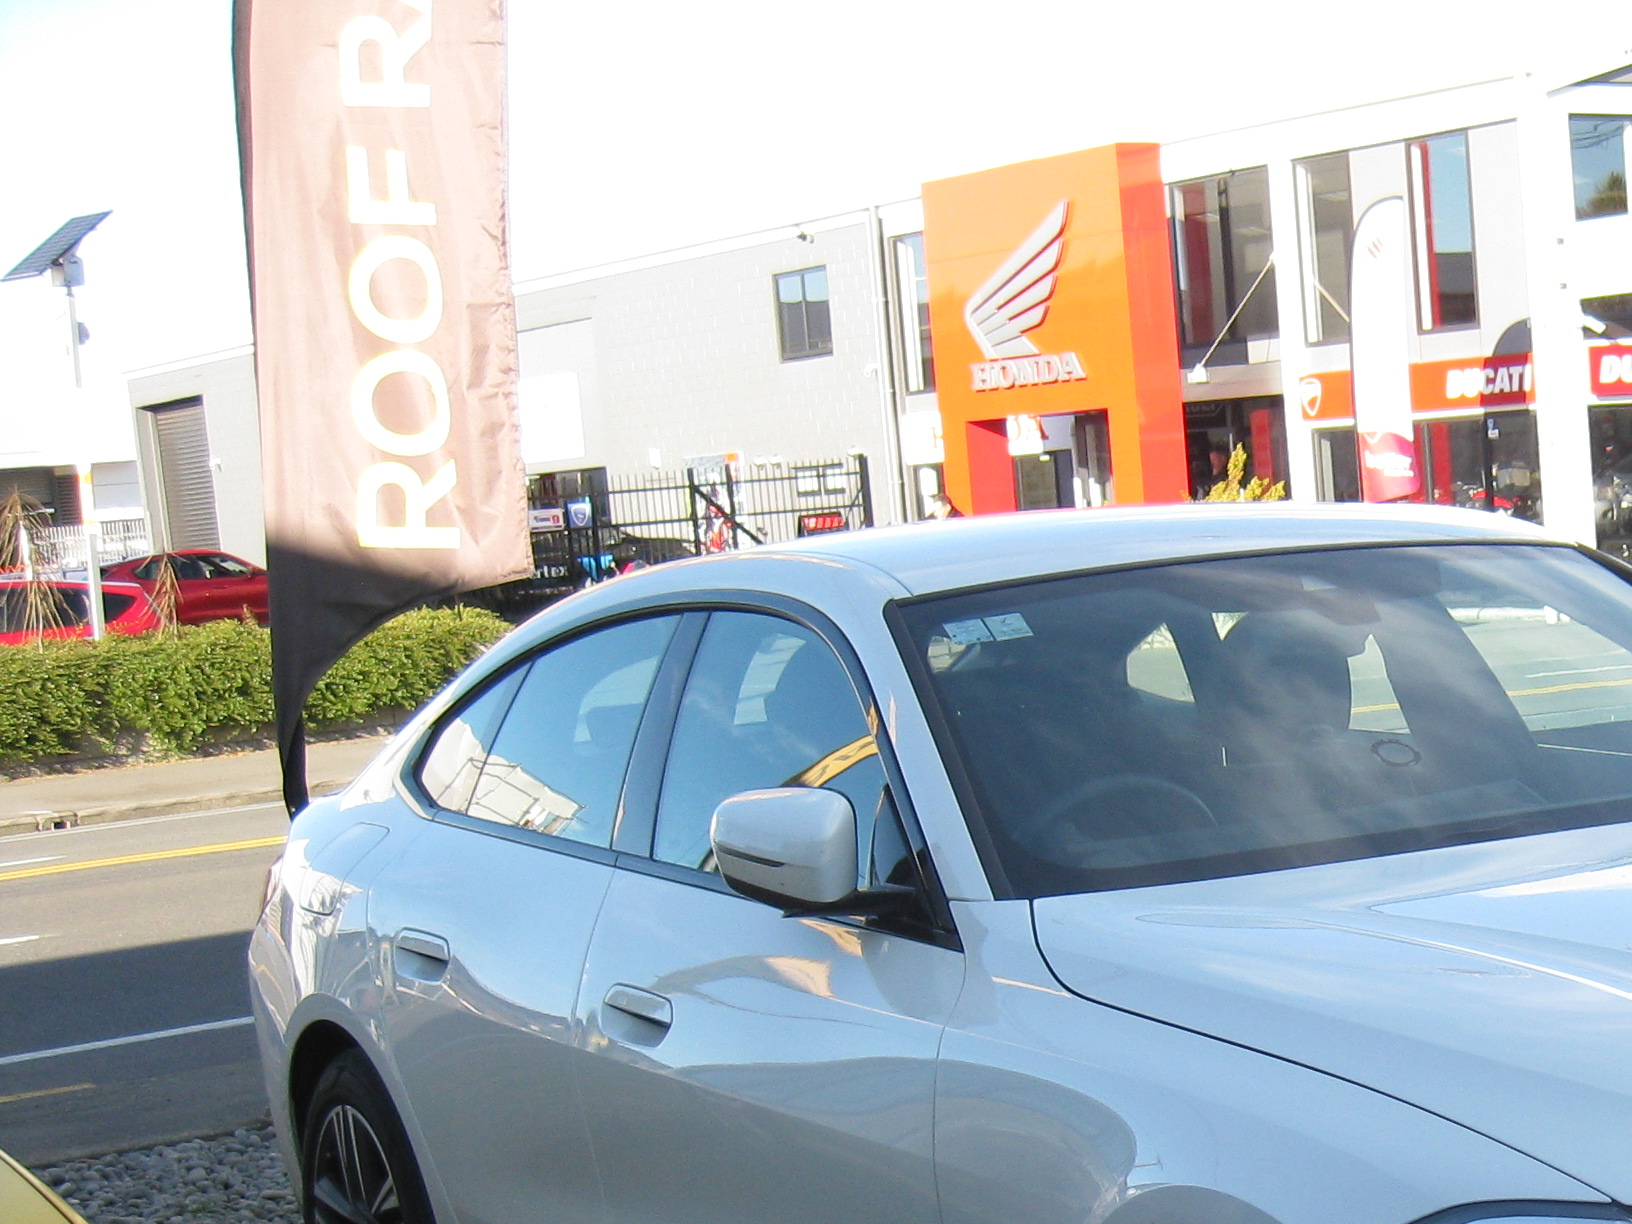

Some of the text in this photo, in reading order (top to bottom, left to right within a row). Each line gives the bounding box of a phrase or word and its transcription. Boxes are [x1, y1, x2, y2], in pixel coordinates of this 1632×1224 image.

[338, 0, 461, 549] ROOF R
[970, 352, 1088, 392] HONDA
[1446, 364, 1532, 399] DUCATI
